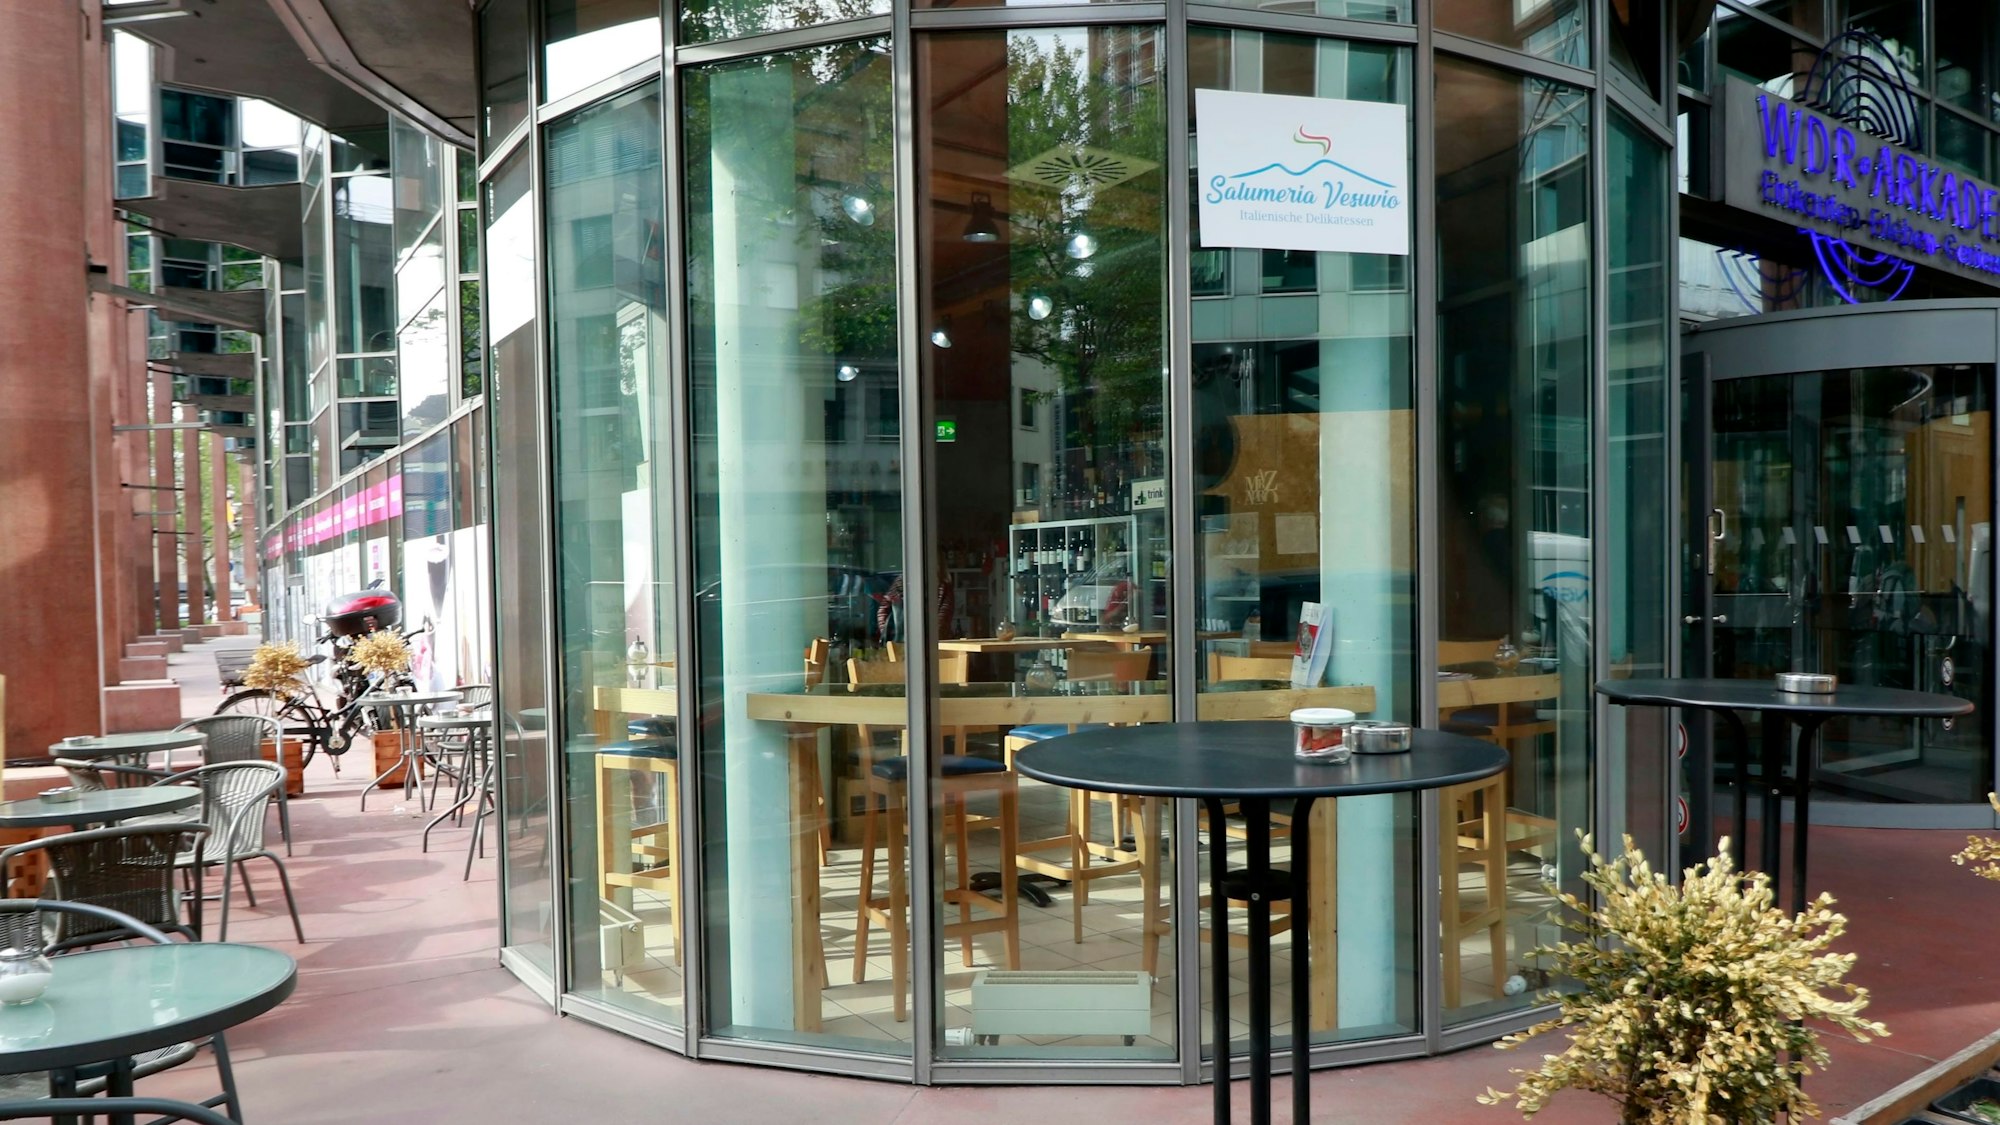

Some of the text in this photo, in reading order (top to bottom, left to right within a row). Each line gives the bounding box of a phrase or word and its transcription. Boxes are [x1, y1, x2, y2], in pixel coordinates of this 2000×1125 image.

[1757, 95, 1857, 188] WDR
[1206, 175, 1400, 209] Salumeria Vesuvio
[1240, 210, 1374, 227] Italienische Delikatessen
